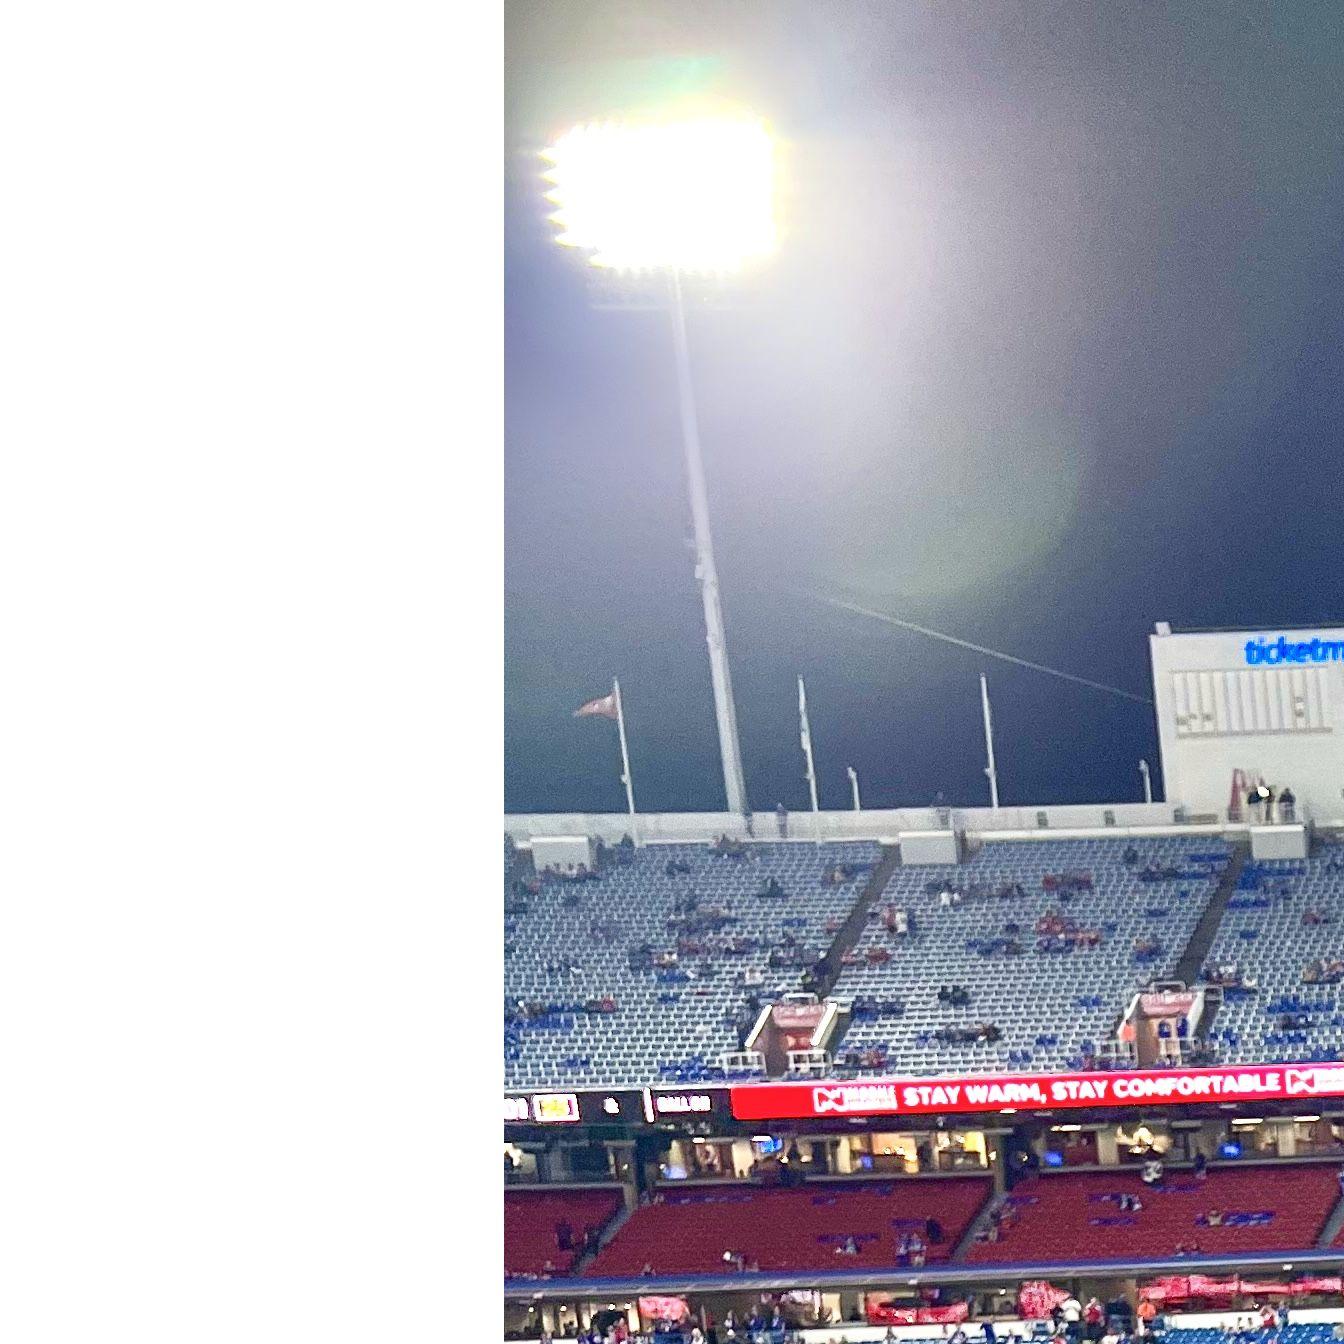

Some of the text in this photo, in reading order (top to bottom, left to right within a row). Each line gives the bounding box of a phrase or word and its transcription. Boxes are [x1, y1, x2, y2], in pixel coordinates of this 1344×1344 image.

[903, 1086, 960, 1107] STAY
[965, 1082, 1047, 1104] WARM,
[1051, 1080, 1108, 1100] STAY
[1112, 1072, 1281, 1098] COMFORTABLE
